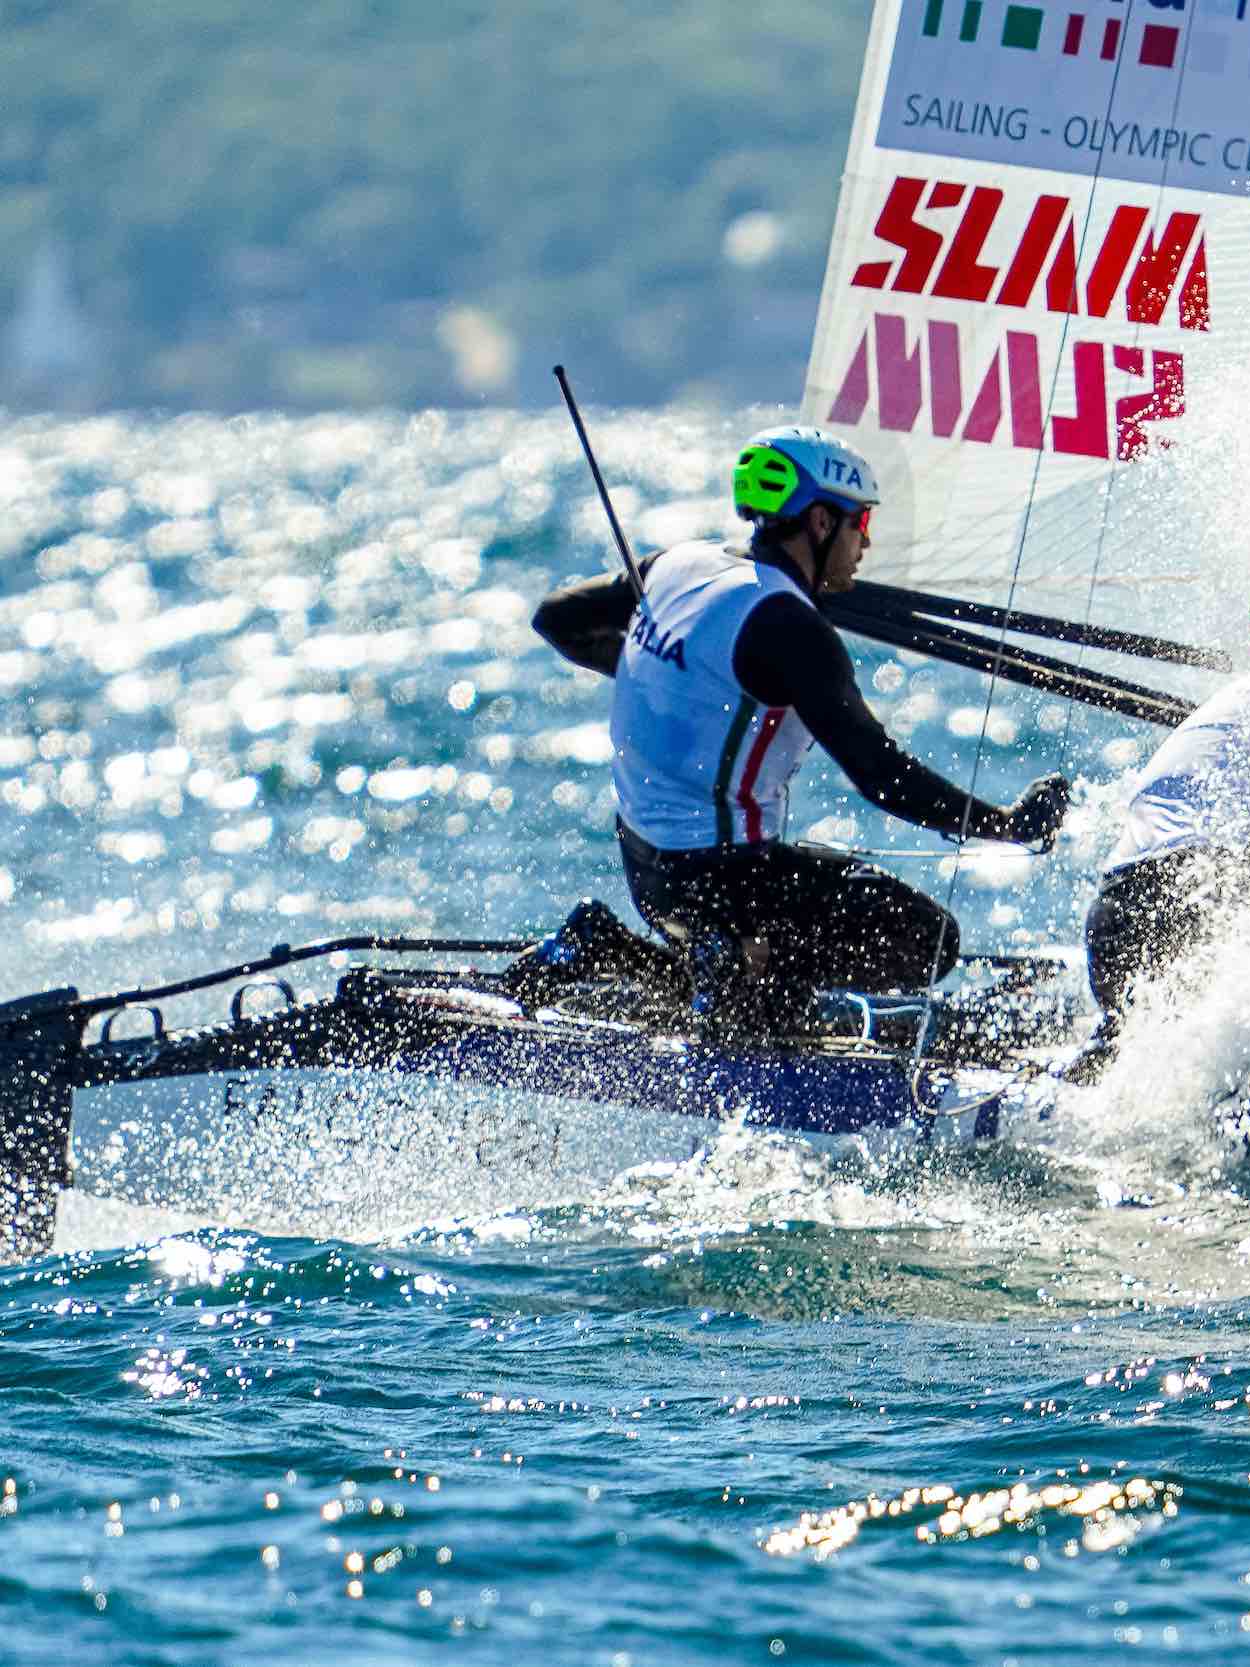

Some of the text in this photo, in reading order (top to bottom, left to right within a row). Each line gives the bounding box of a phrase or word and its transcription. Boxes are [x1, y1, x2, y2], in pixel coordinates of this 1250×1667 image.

[904, 93, 1029, 141] SAILING
[1063, 116, 1211, 166] OLYMPIC
[850, 176, 1210, 332] SLAM
[824, 456, 863, 489] ITA
[630, 613, 688, 672] ALIA
